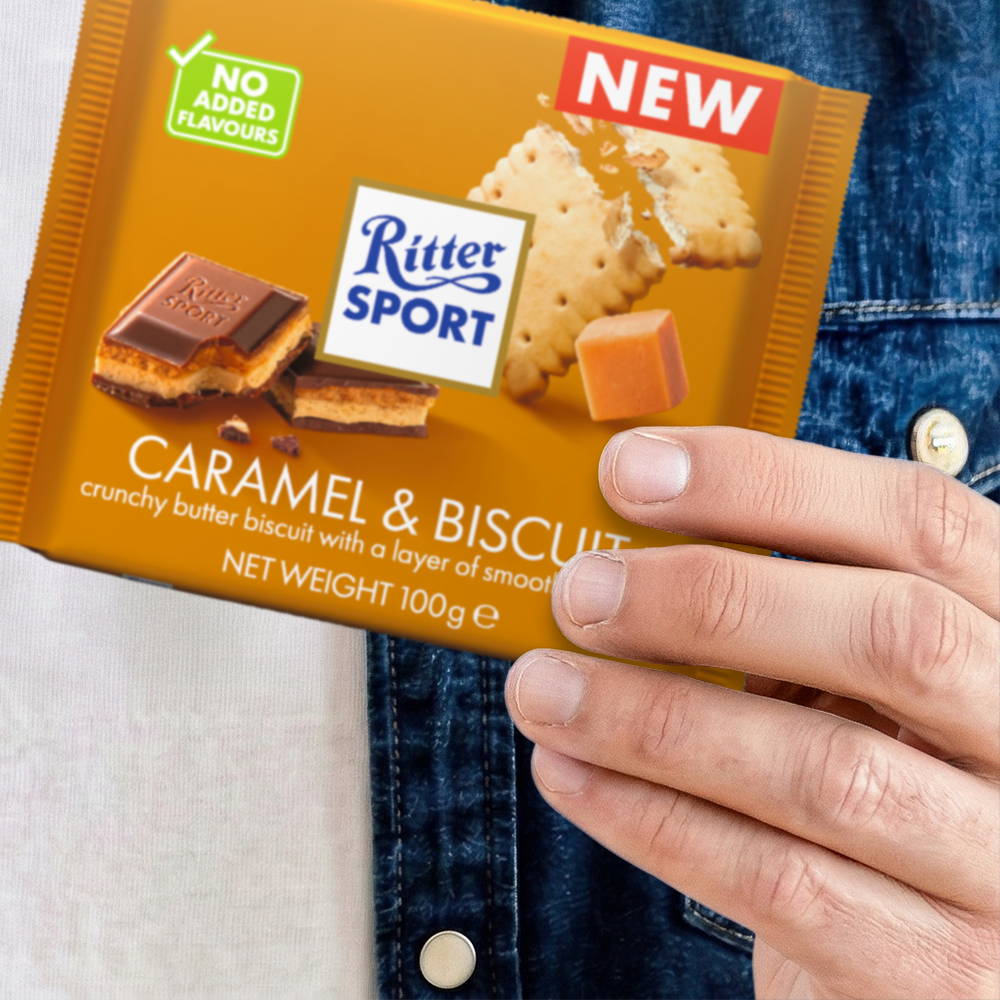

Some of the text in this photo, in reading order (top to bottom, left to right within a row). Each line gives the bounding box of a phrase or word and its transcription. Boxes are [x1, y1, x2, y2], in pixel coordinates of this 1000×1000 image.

[193, 90, 275, 122] ADDED
[211, 63, 268, 97] NO
[577, 51, 763, 136] NEW
[177, 110, 279, 145] FLAVOURS
[353, 214, 507, 294] Ritter
[161, 295, 230, 327] SPORT
[343, 285, 495, 347] SPORT
[129, 435, 366, 524] CARAMEL
[382, 488, 419, 535] &
[80, 481, 555, 594] crunchy butter biscuit with a layer of smoot
[222, 549, 276, 581] NET
[281, 560, 394, 606] WEIGHT
[401, 586, 465, 629] 100g
